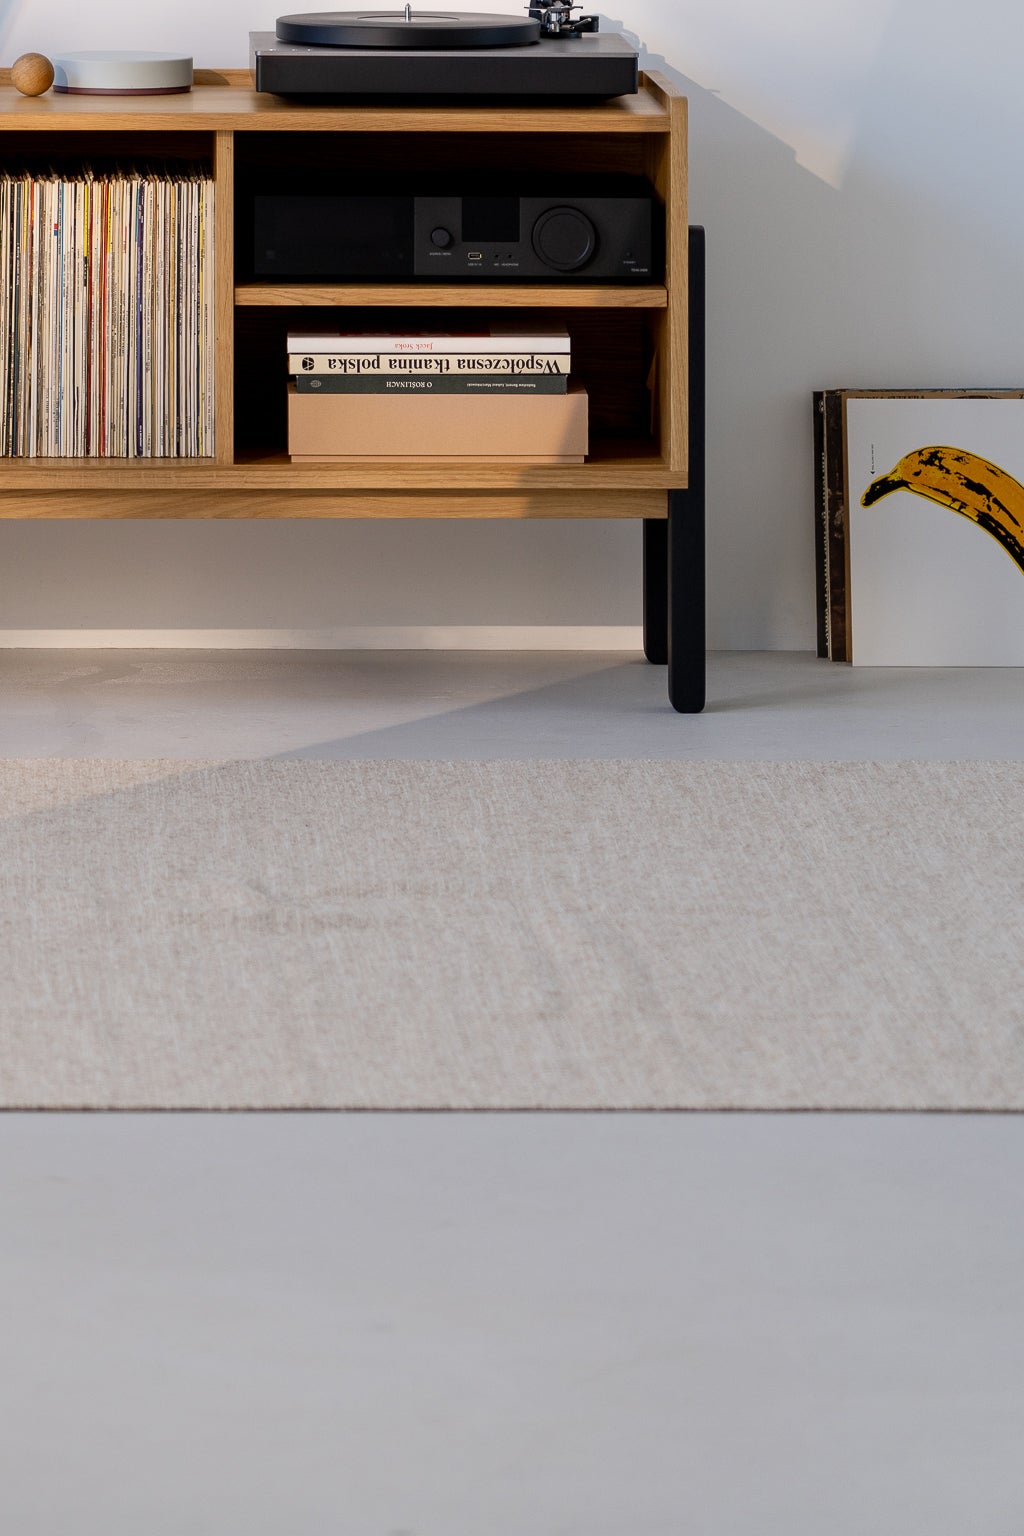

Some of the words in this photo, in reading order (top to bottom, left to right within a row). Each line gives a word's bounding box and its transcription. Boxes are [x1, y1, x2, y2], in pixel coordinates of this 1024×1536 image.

[327, 355, 381, 374] polska
[388, 358, 450, 373] tkanina
[456, 355, 562, 374] Współczesna
[386, 381, 426, 389] ROŚLINACH
